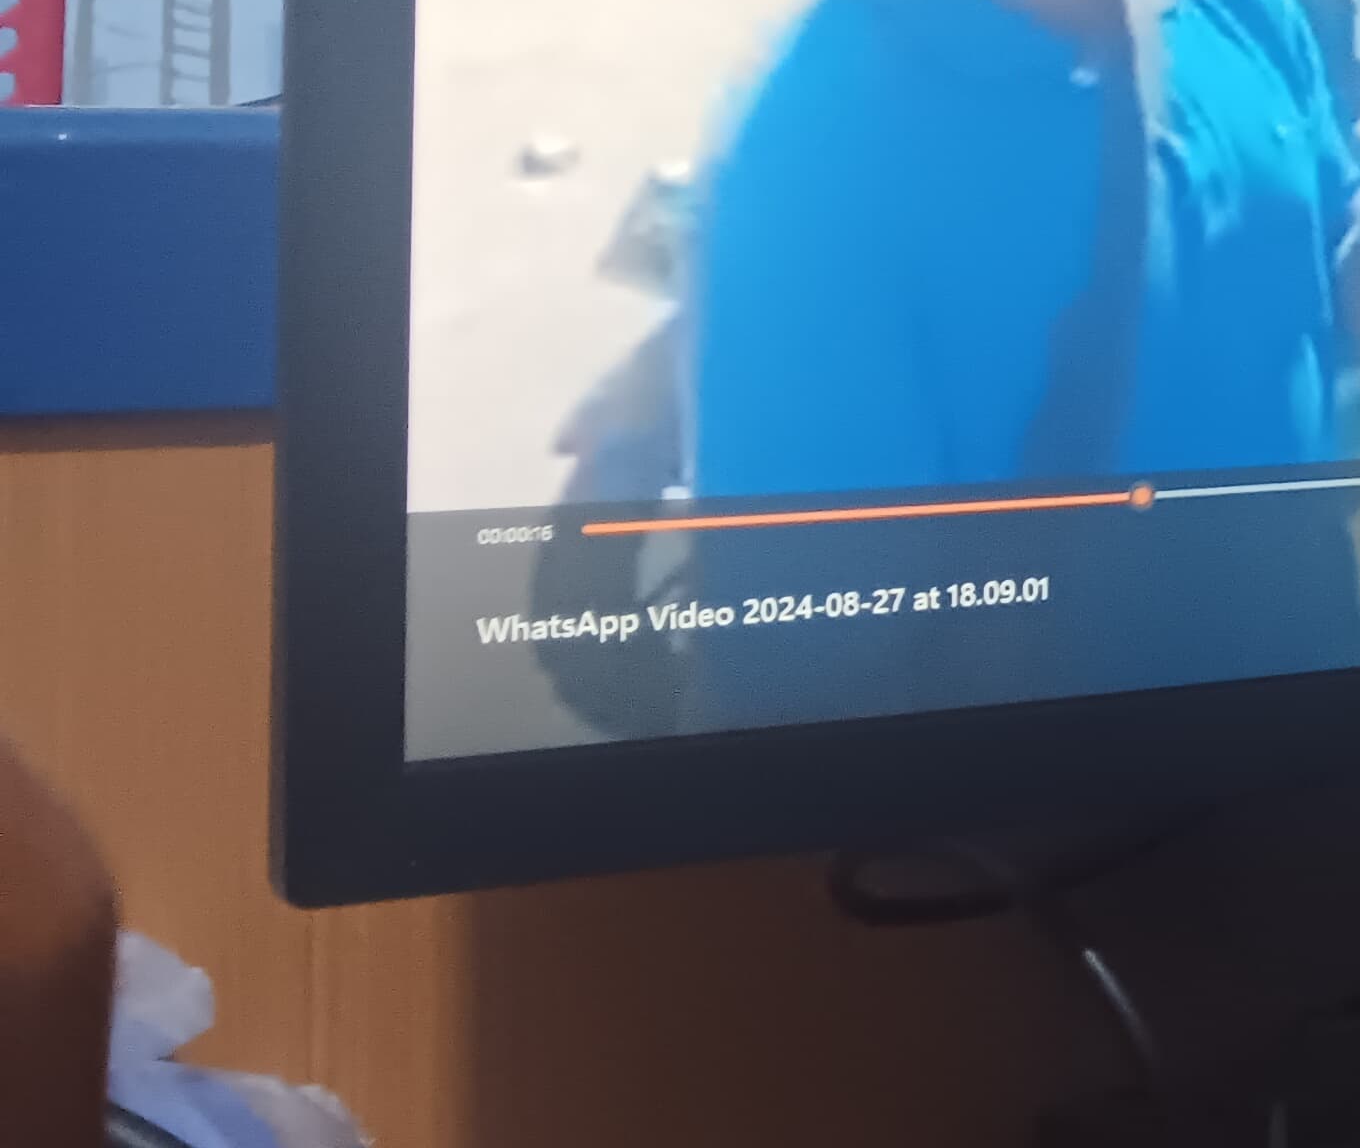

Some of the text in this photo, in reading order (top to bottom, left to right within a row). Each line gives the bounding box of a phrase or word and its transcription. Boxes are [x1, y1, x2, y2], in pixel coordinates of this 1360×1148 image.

[476, 576, 1050, 644] WhatsApp Video 2024-08-27 at 18.09.01
